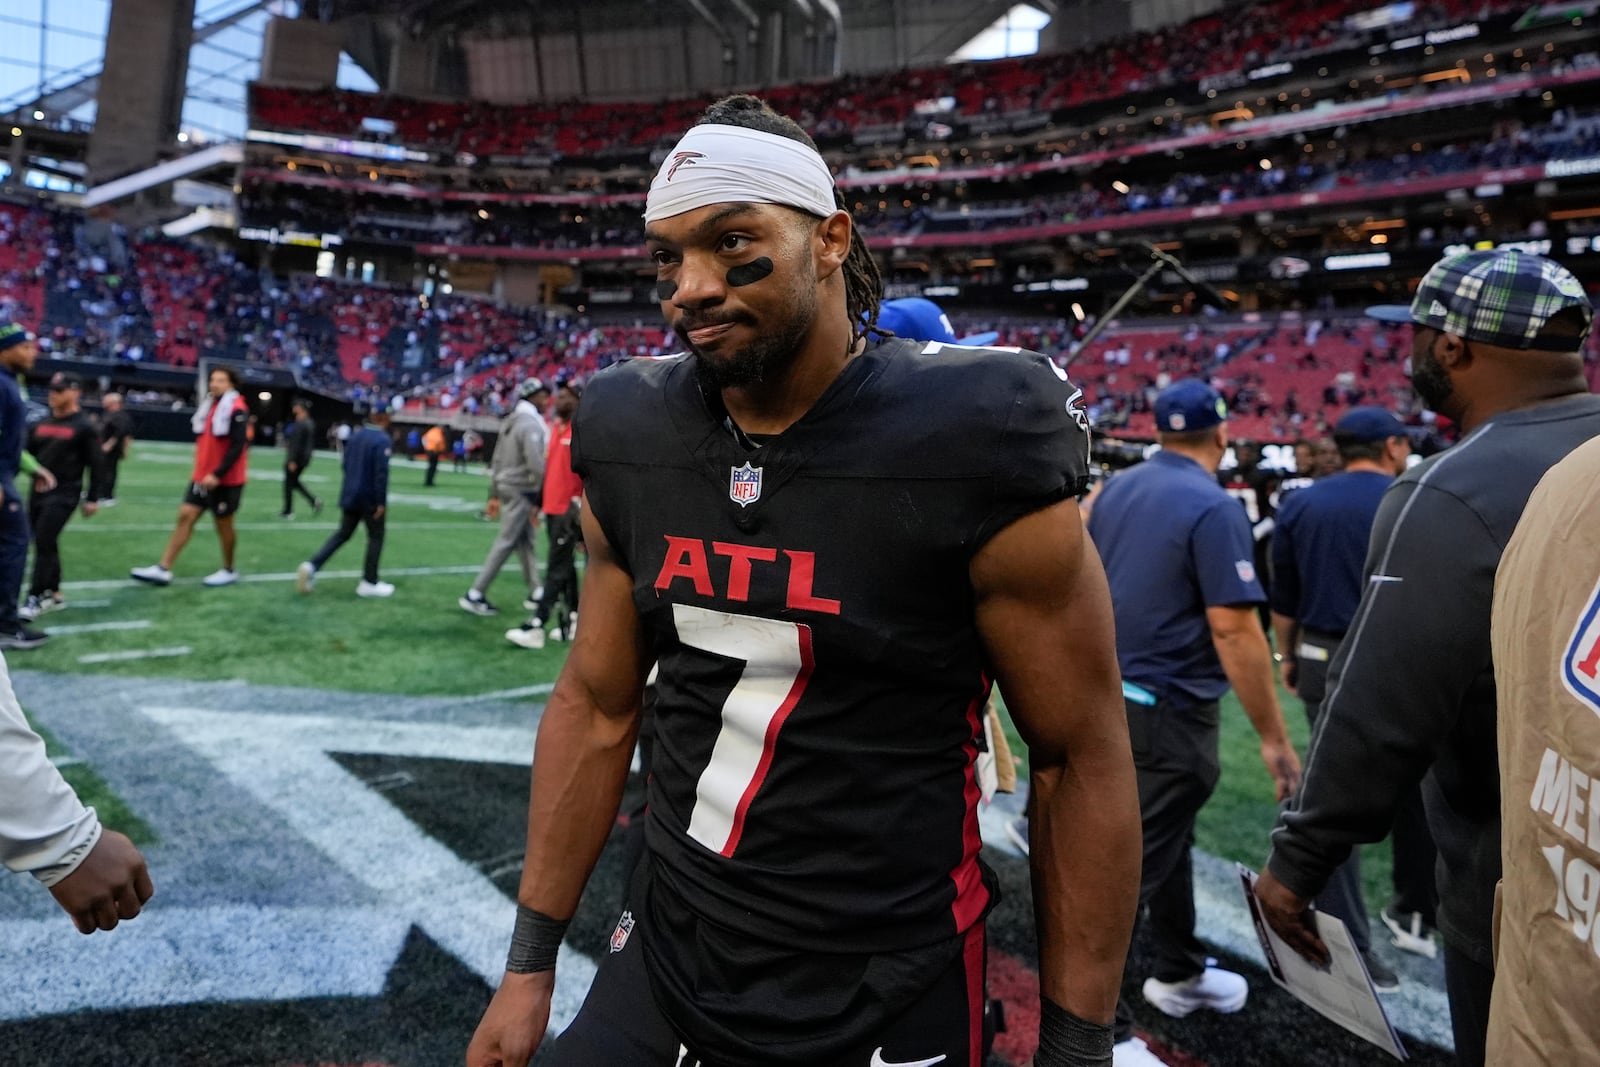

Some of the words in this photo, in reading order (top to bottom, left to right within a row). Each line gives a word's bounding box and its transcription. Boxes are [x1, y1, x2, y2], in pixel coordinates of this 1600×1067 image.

[734, 482, 755, 499] NFL
[654, 535, 841, 615] ATL
[672, 603, 816, 858] 7
[1542, 844, 1600, 957] 19
